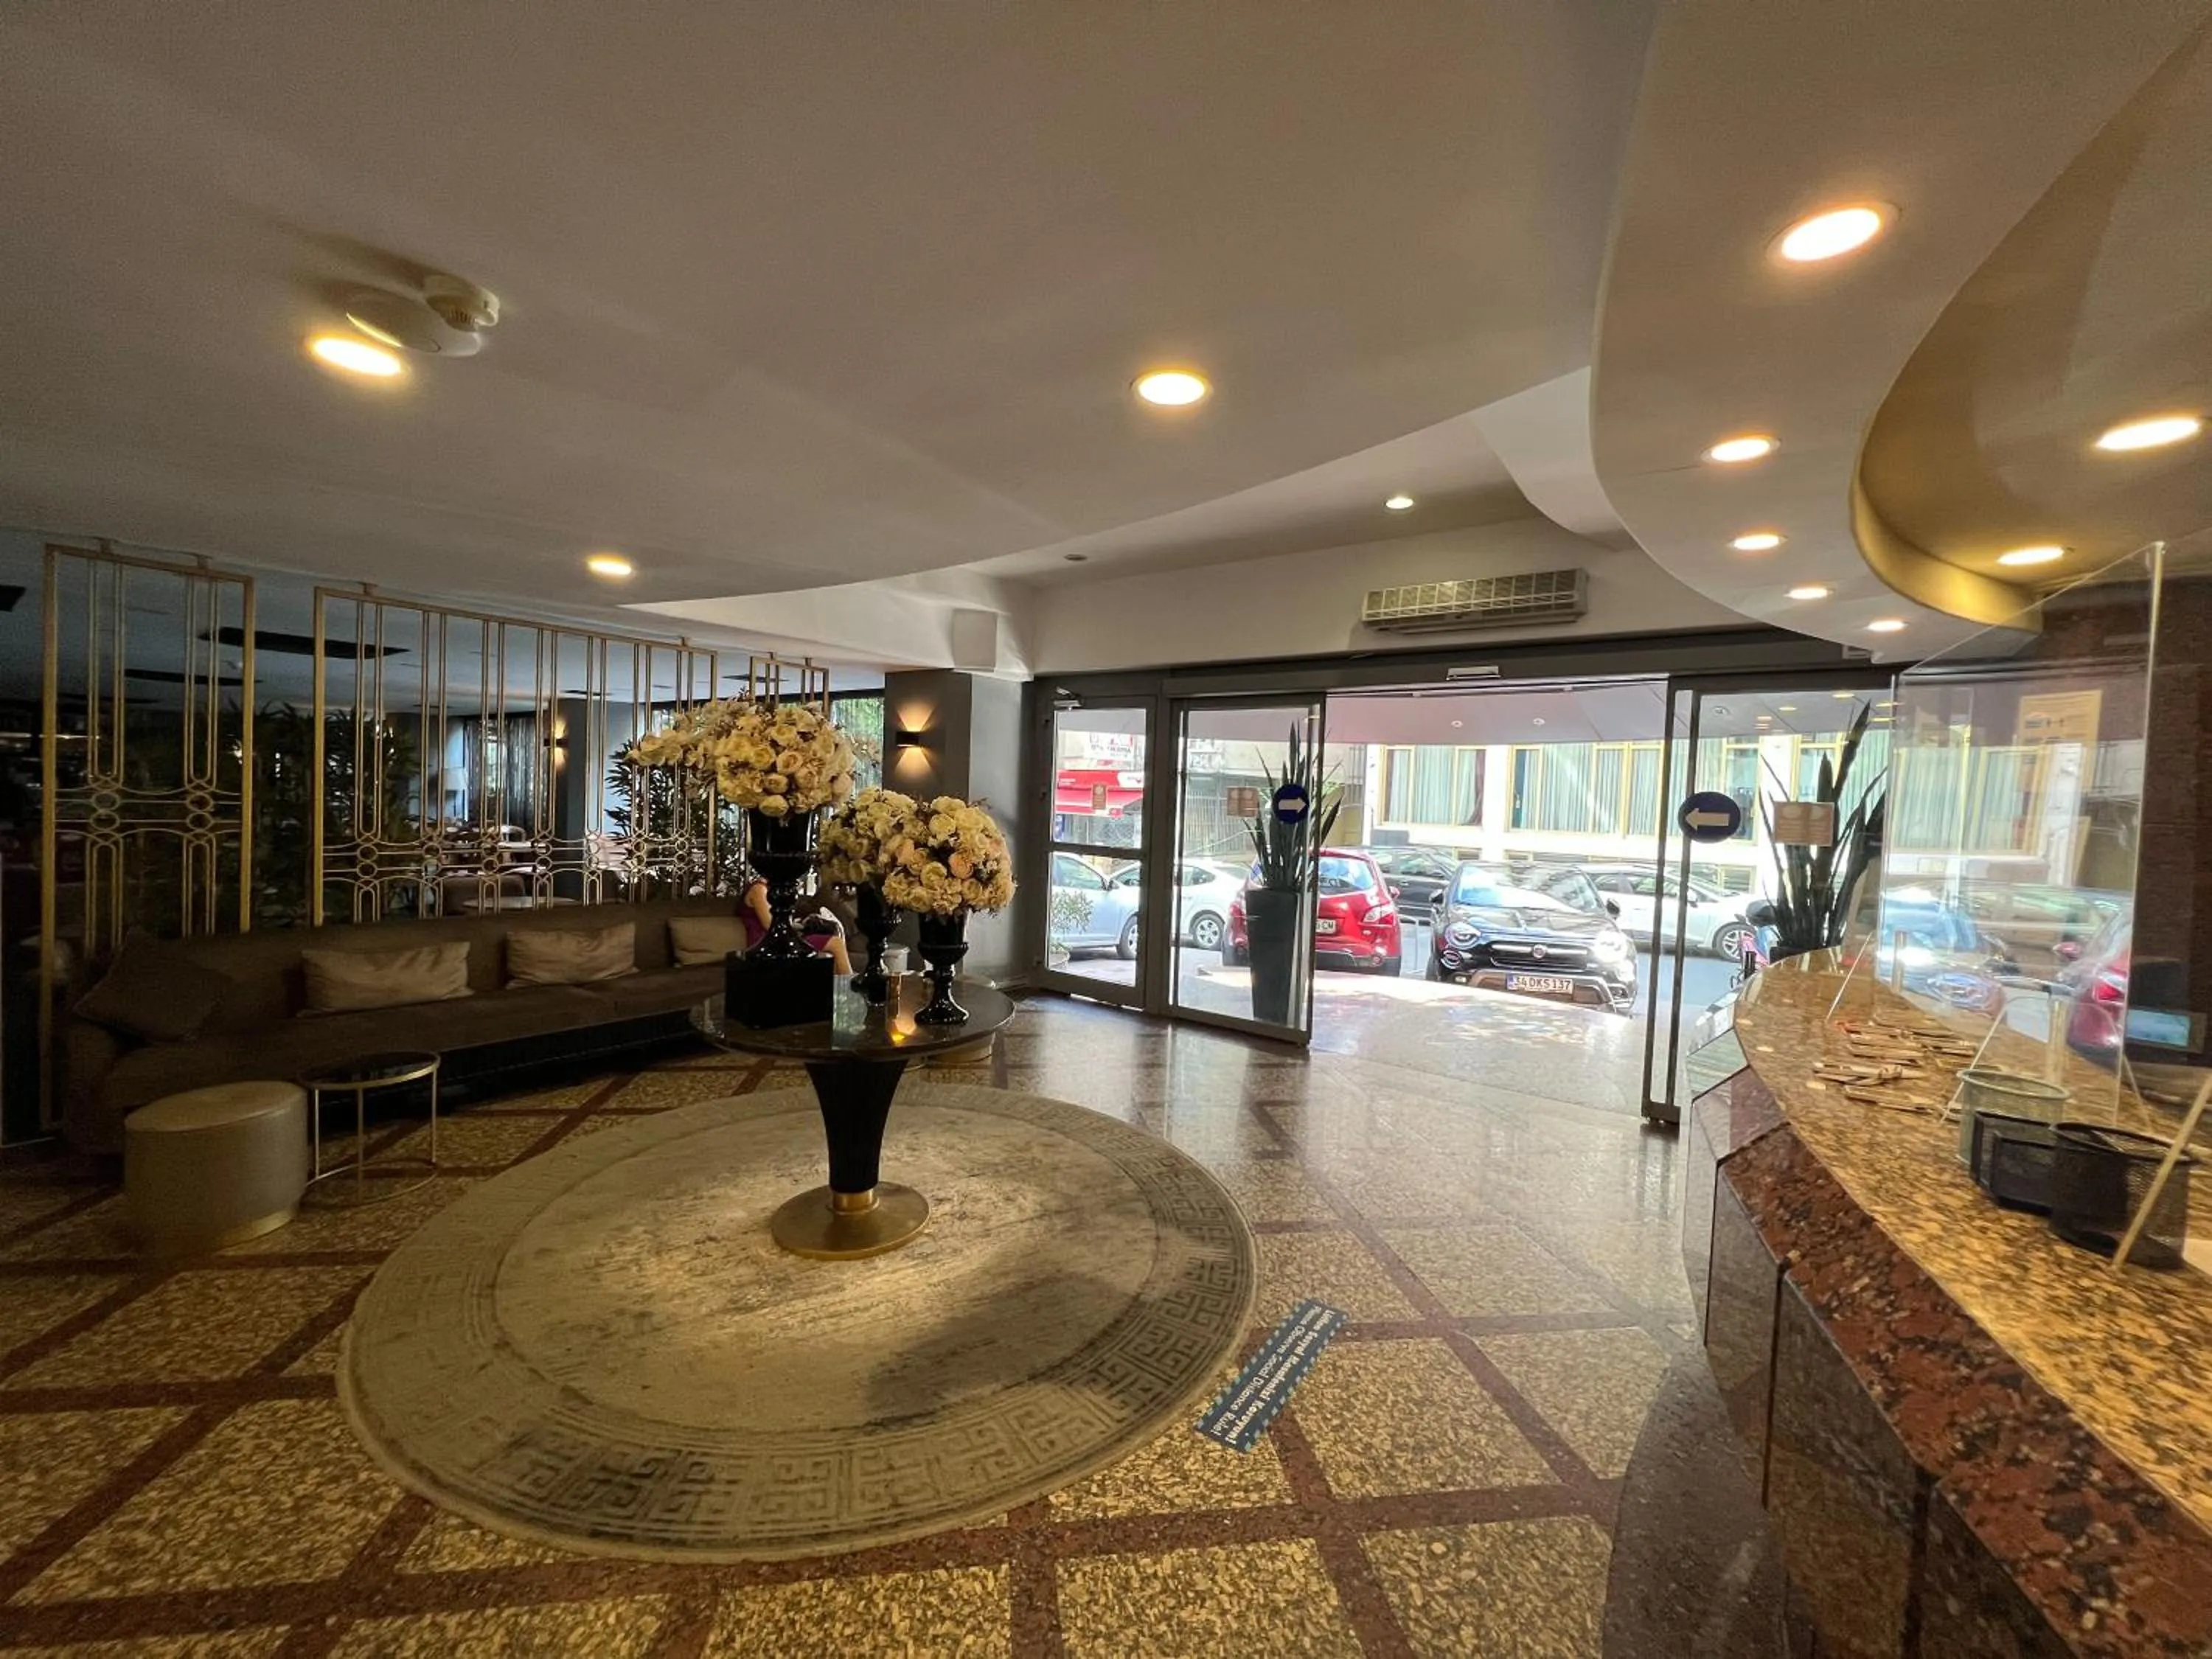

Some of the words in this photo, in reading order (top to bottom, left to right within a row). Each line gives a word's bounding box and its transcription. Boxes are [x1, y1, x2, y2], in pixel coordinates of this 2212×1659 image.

[1552, 978, 1571, 990] 137
[1257, 1354, 1280, 1378] Social
[1230, 1377, 1264, 1411] Distance
